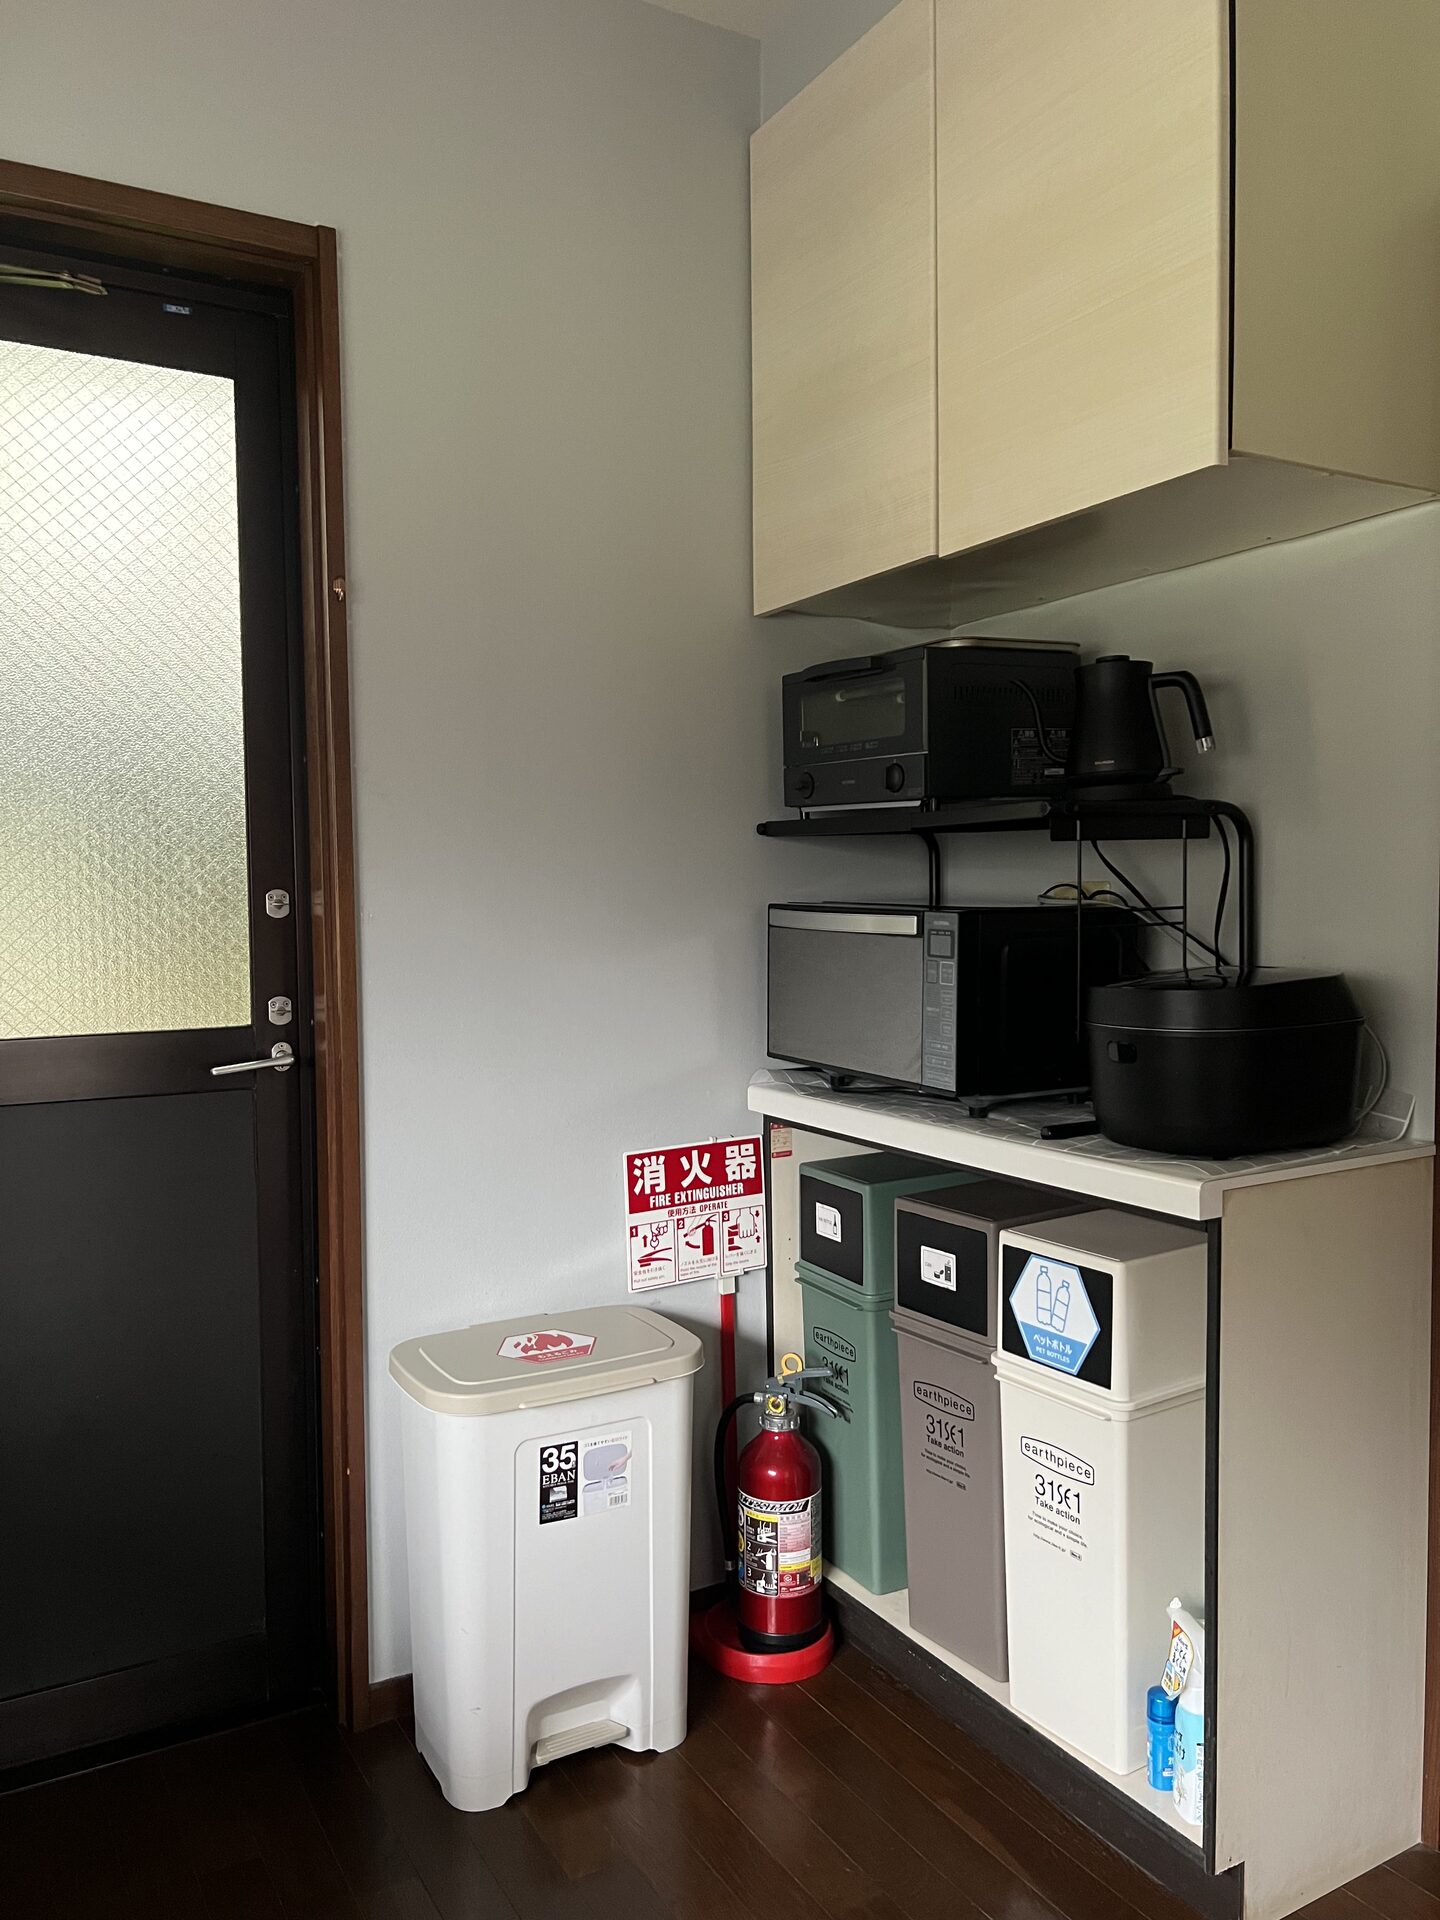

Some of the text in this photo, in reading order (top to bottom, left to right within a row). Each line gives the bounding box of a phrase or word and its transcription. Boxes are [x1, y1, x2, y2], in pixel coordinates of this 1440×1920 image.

[633, 1143, 757, 1196] 消火器
[649, 1182, 744, 1209] FIRE EXTINGUISHER
[667, 1201, 728, 1218] 使用方法 OPERATE
[723, 1212, 729, 1221] 3
[678, 1220, 684, 1229] 2
[815, 1331, 854, 1357] earthpiece
[1033, 1334, 1073, 1355] ペットボトル
[1036, 1346, 1070, 1364] PET BOTTLES
[916, 1386, 972, 1416] earthpiece
[927, 1434, 965, 1458] Take action
[542, 1443, 576, 1473] 35
[1024, 1442, 1091, 1479] earthpiece
[542, 1470, 576, 1486] EBAN
[1035, 1496, 1081, 1525] Take action
[747, 1541, 752, 1551] 2
[747, 1568, 752, 1577] 3
